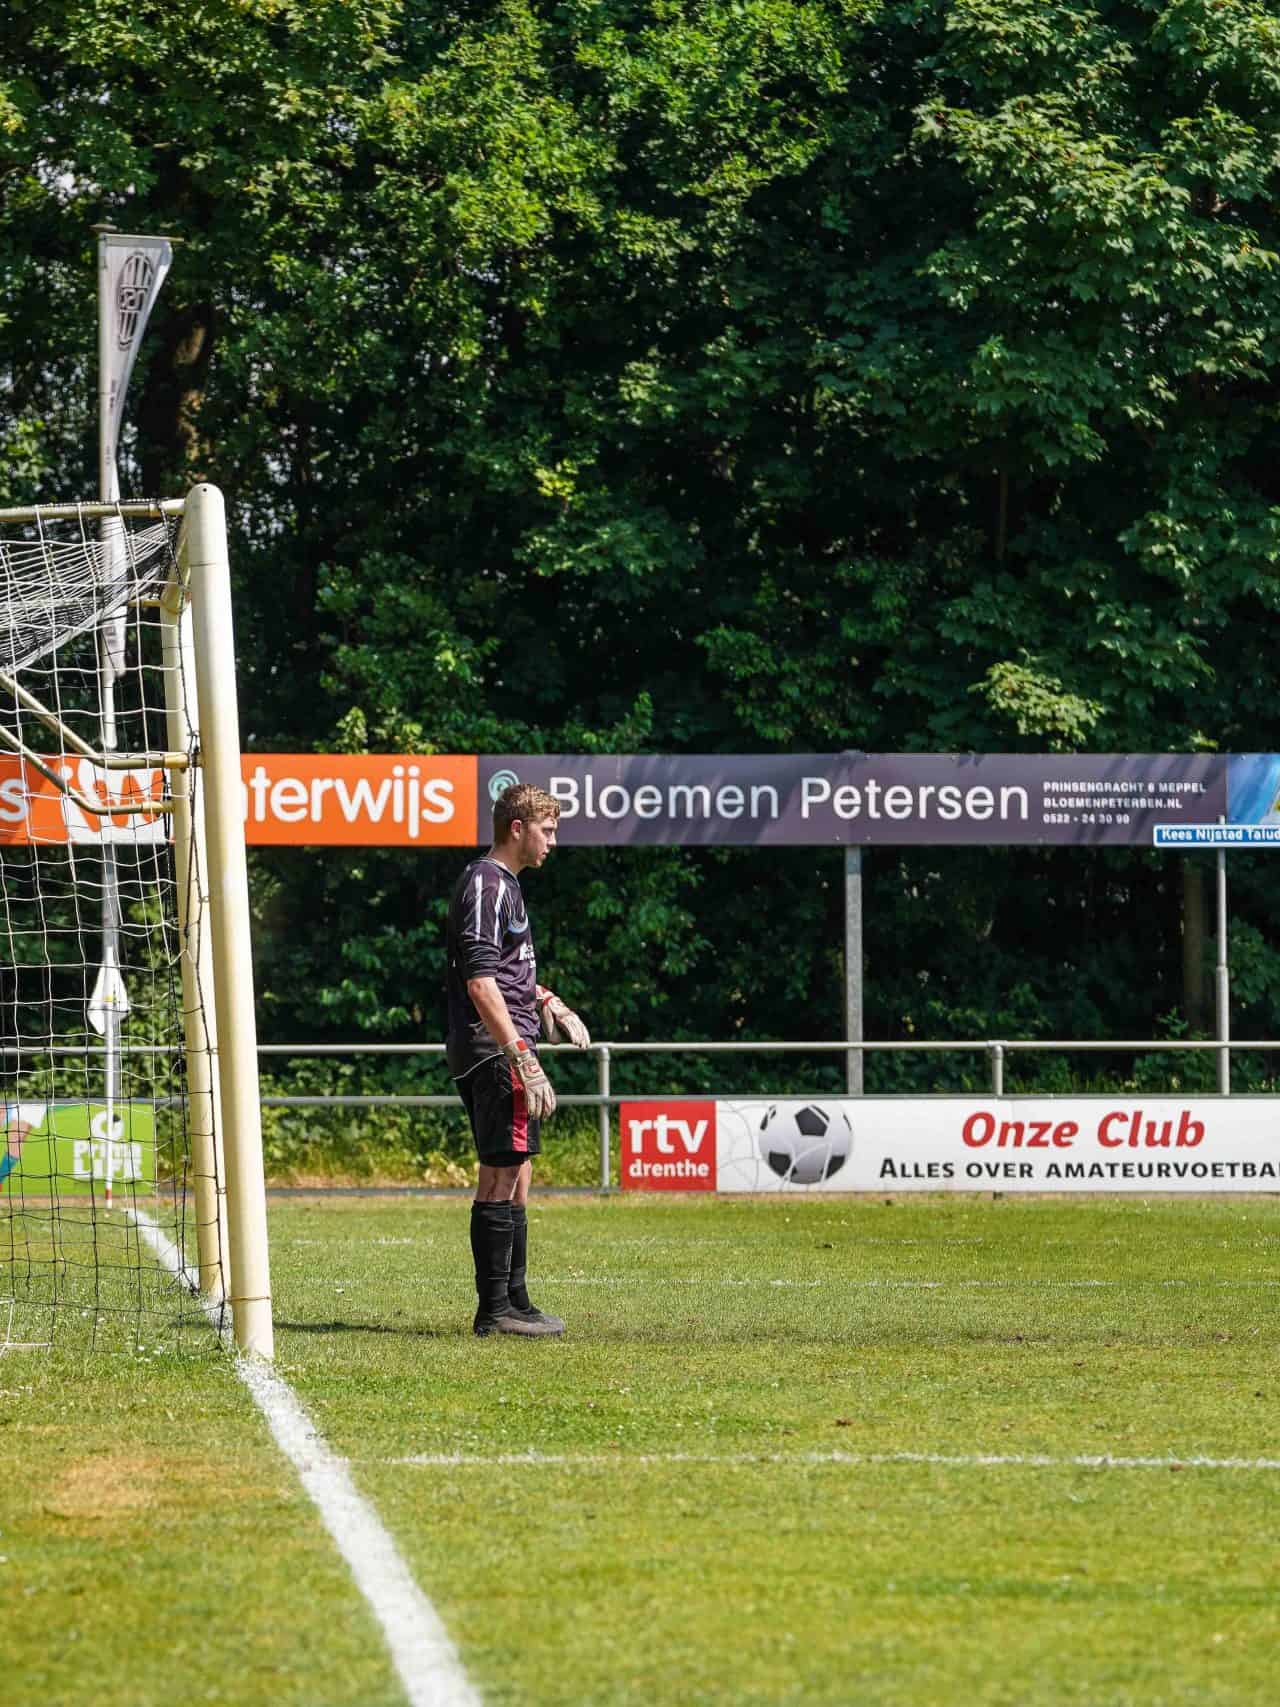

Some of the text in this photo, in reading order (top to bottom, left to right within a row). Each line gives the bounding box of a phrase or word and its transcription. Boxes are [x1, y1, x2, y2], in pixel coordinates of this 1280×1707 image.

[1042, 781, 1144, 793] PRINSENGRACHT
[1159, 782, 1207, 793] MEPPEL
[241, 765, 455, 838] terwijs
[549, 775, 1029, 820] Bloemen Petersen
[1043, 797, 1183, 809] BLOEMENPETERSEN.NL
[1162, 828, 1193, 841] Kees
[1196, 828, 1243, 843] Nijstad
[628, 1114, 709, 1153] rtv
[962, 1110, 1206, 1148] Onze Club
[629, 1159, 710, 1178] drenthe
[1045, 1162, 1280, 1179] AMATEURVOETBA
